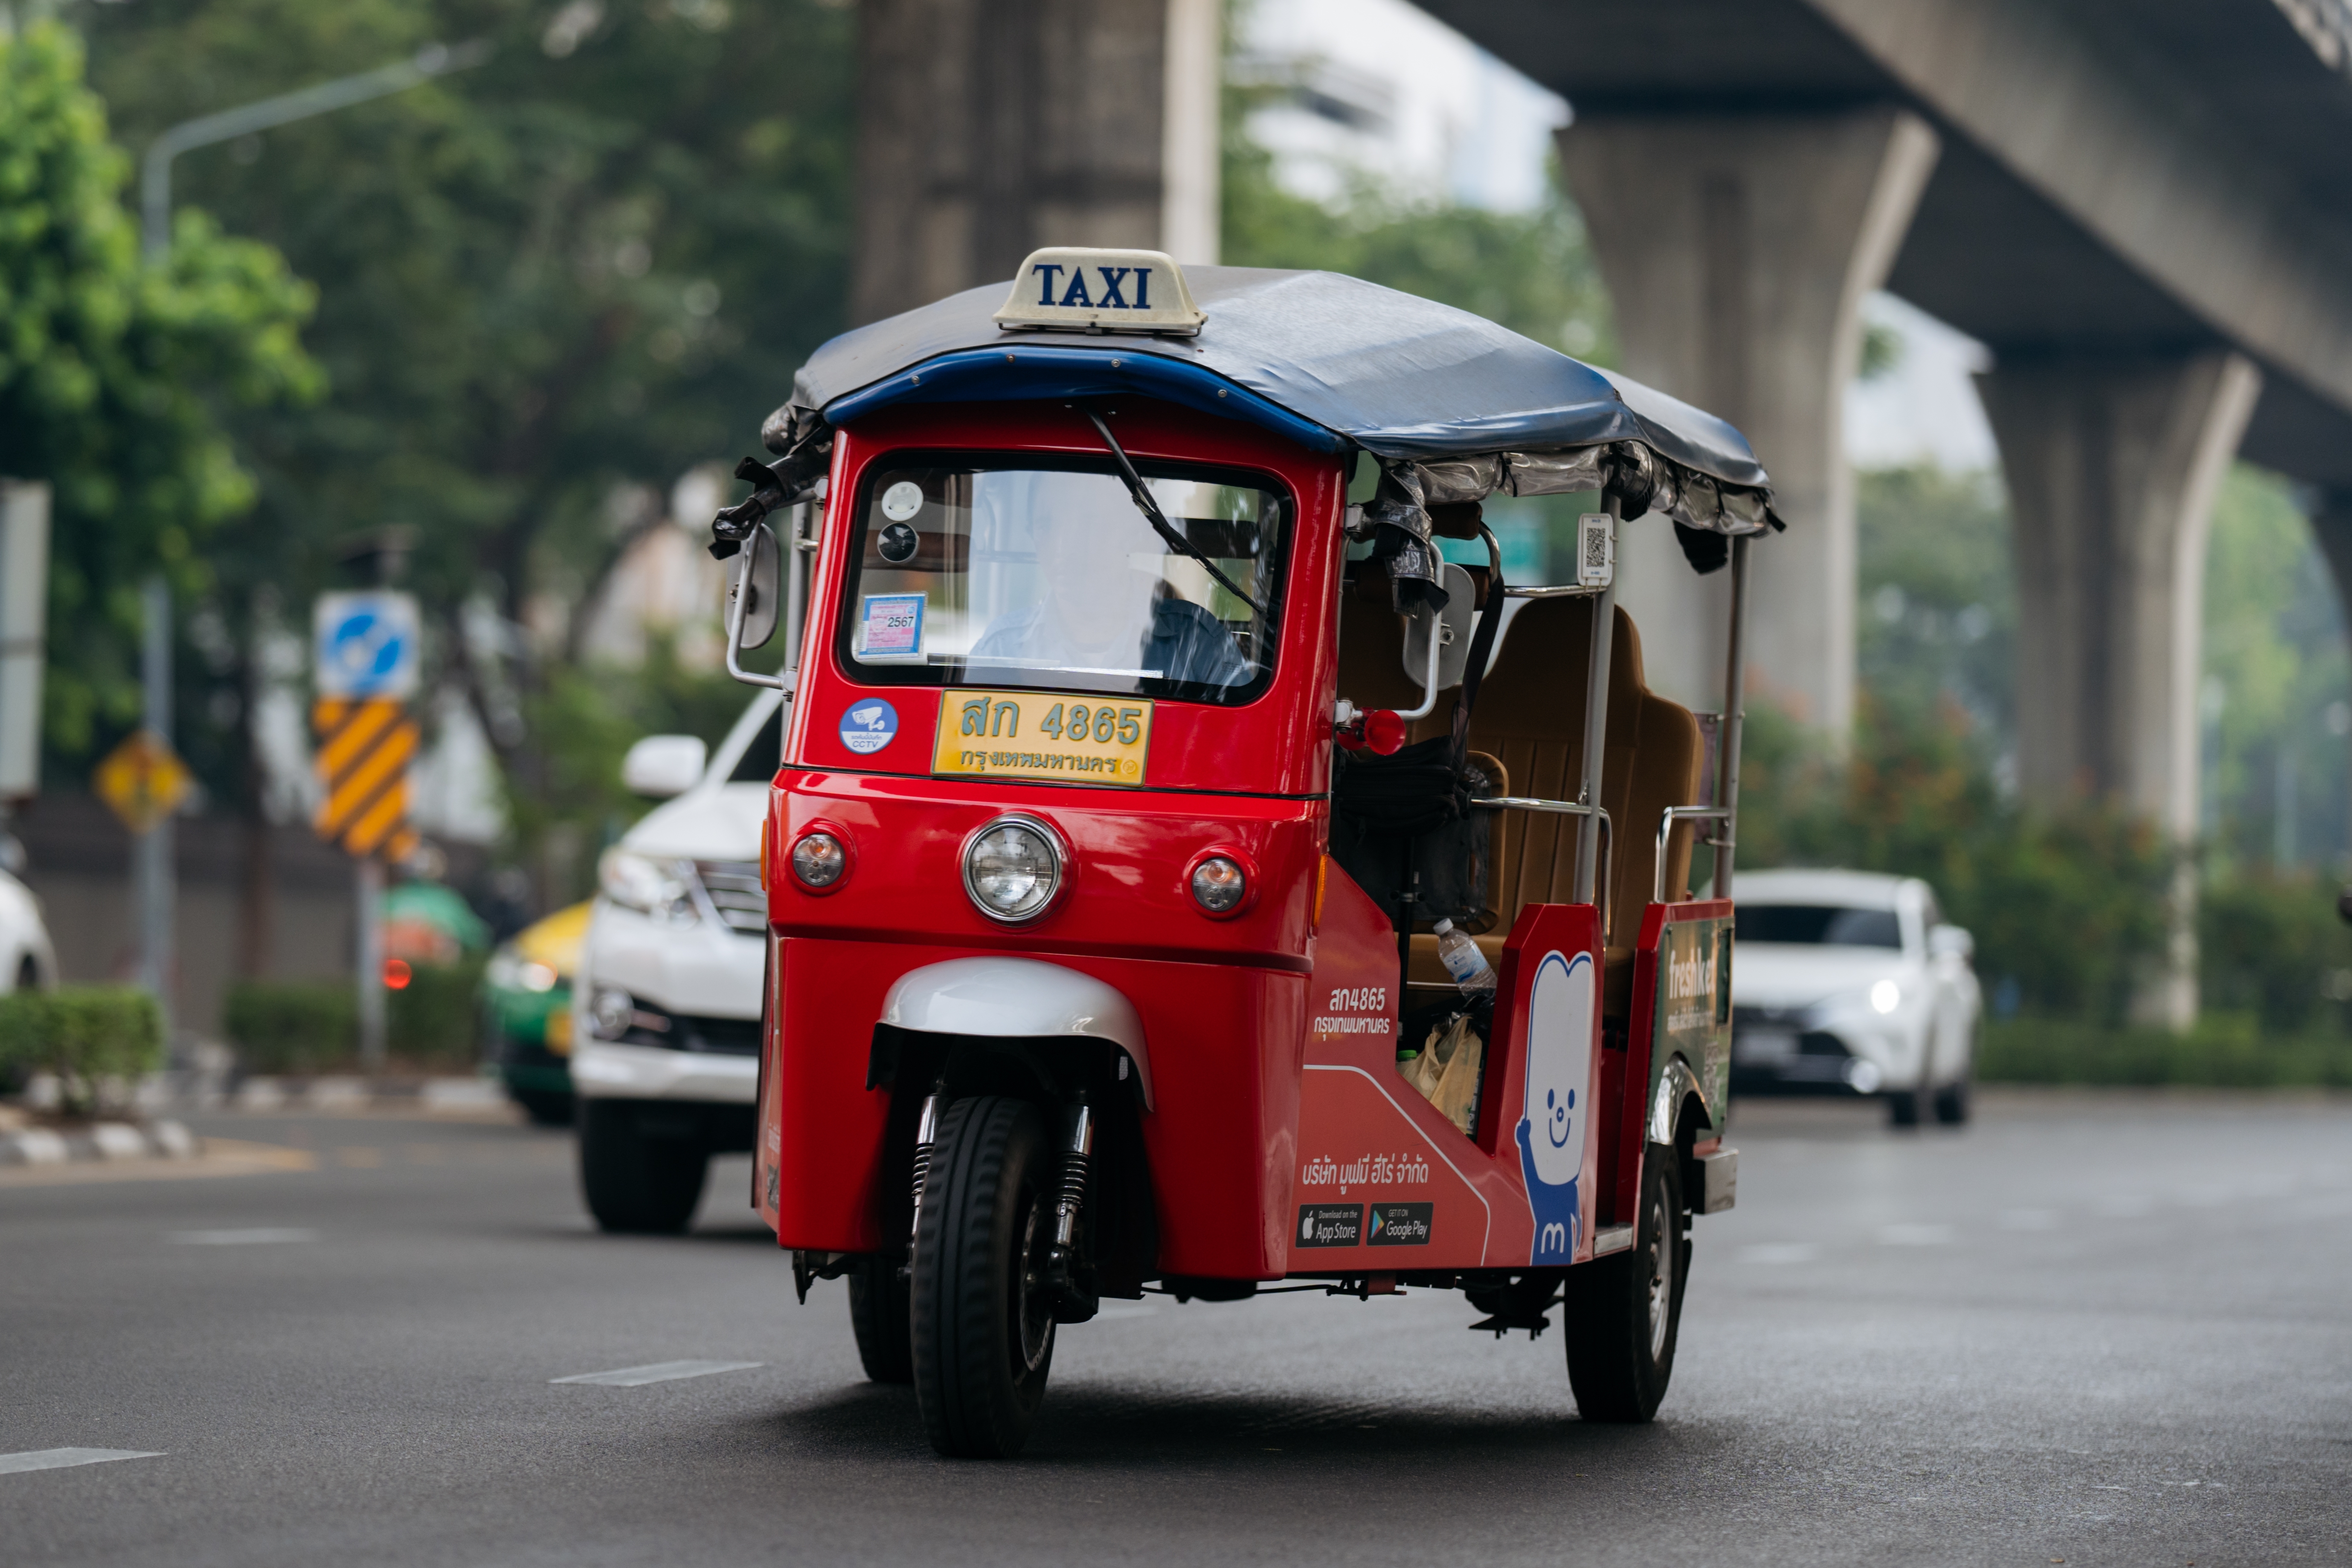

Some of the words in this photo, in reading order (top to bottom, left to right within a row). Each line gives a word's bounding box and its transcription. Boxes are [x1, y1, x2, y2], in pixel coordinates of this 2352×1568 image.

[1032, 264, 1153, 309] TAXI
[887, 616, 914, 627] 2567
[961, 696, 1019, 737] สก
[1041, 703, 1141, 744] 4865
[961, 750, 1117, 772] กรุงเทพมหานคร
[1329, 987, 1385, 1011] สก4865
[1314, 1016, 1390, 1041] กรุงเทพมหานคร
[1303, 1155, 1337, 1185] บริษัท
[1339, 1153, 1370, 1195] มูฟมี
[1371, 1153, 1395, 1184] ฮีโร่
[1397, 1153, 1429, 1183] จำกัด
[1318, 1210, 1342, 1219] Download
[1349, 1210, 1357, 1218] the
[1388, 1209, 1397, 1217] GET
[1316, 1223, 1333, 1243] App
[1333, 1222, 1356, 1239] Store
[1386, 1220, 1412, 1240] Google
[1412, 1220, 1428, 1239] Play
